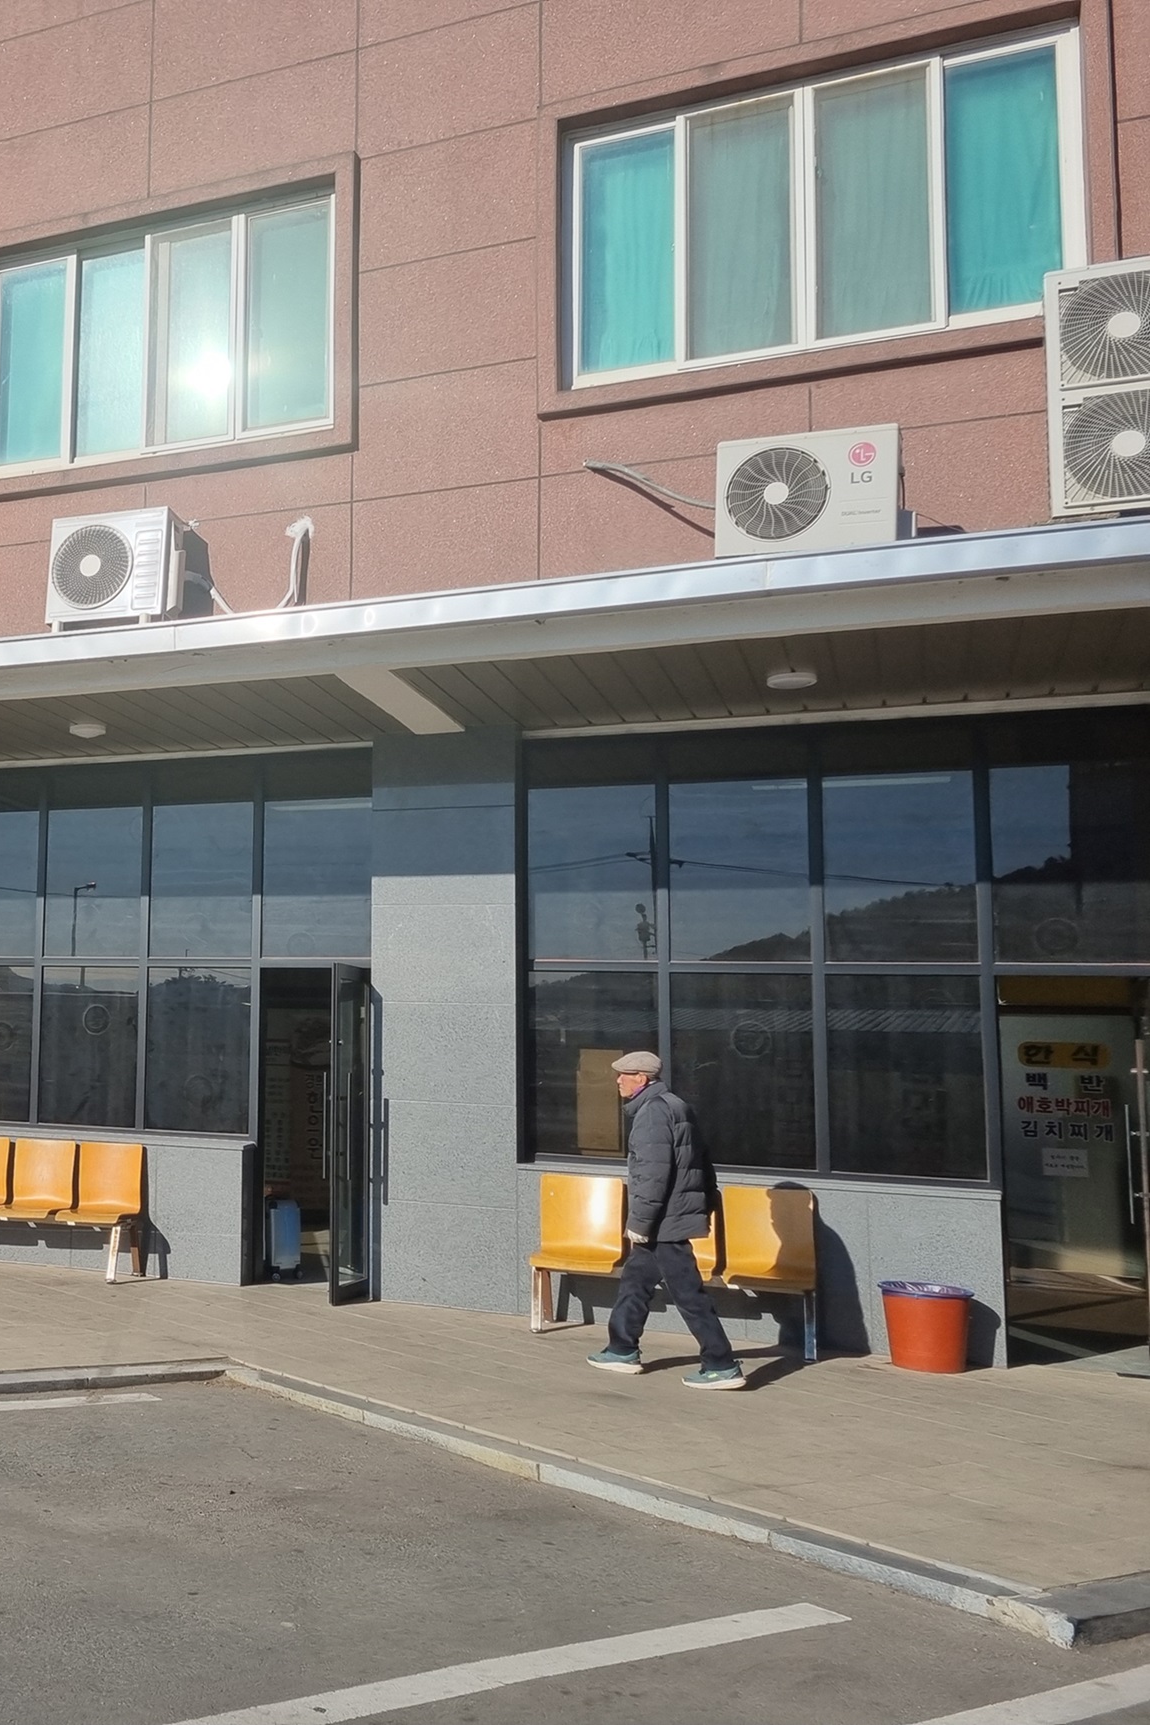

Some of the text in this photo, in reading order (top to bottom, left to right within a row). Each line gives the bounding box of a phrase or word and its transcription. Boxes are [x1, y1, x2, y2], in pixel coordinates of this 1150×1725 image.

[850, 470, 873, 484] LG
[1018, 1096, 1112, 1118] 애호박찌개
[1020, 1120, 1114, 1142] 김치찌개
